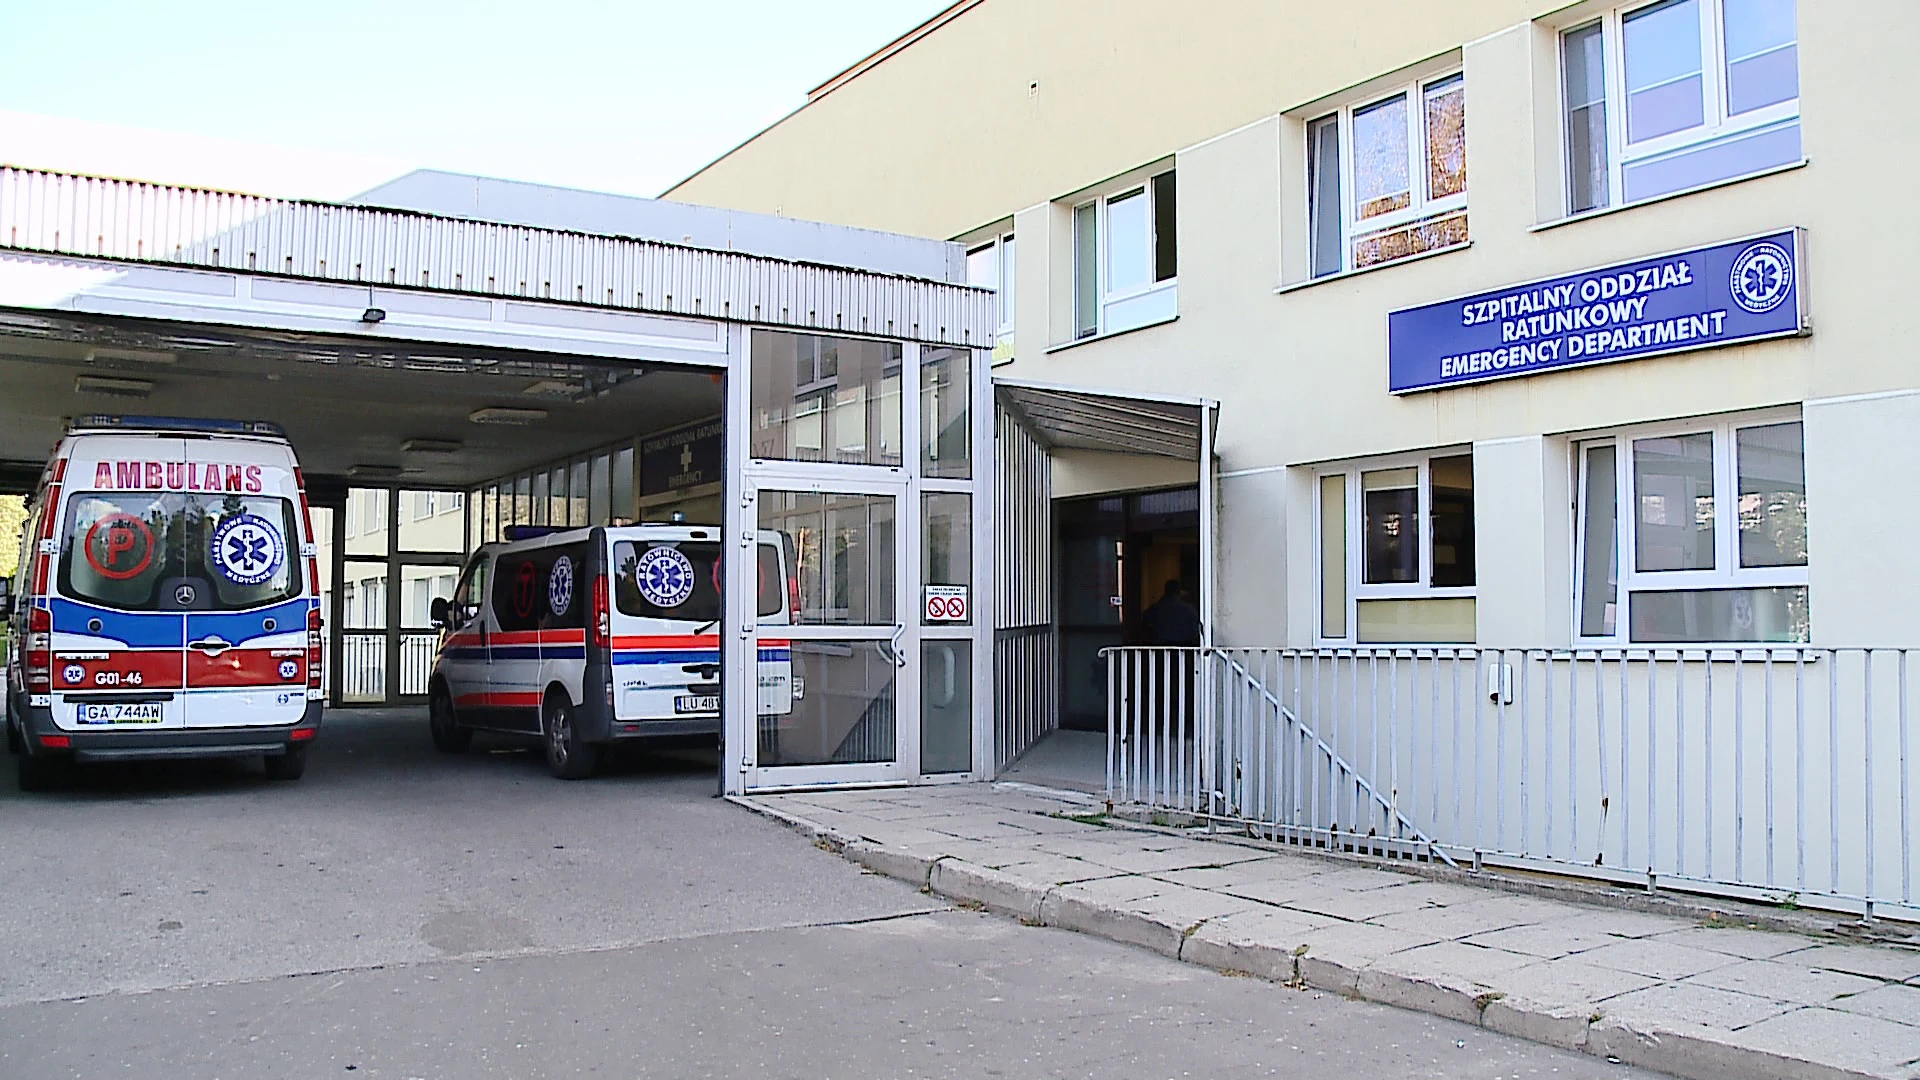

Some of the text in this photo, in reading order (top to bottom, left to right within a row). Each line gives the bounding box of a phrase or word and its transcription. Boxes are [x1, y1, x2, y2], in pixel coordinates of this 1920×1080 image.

[1462, 283, 1576, 326] SZPITALNY
[1580, 262, 1693, 302] ODDZIAŁ
[1502, 296, 1648, 342] RATUNKOWY
[1440, 311, 1727, 379] EMERGENCY DEPARTMENT
[94, 461, 263, 493] AMBULANS
[95, 672, 142, 685] G01-46
[88, 705, 160, 719] GA 744AW
